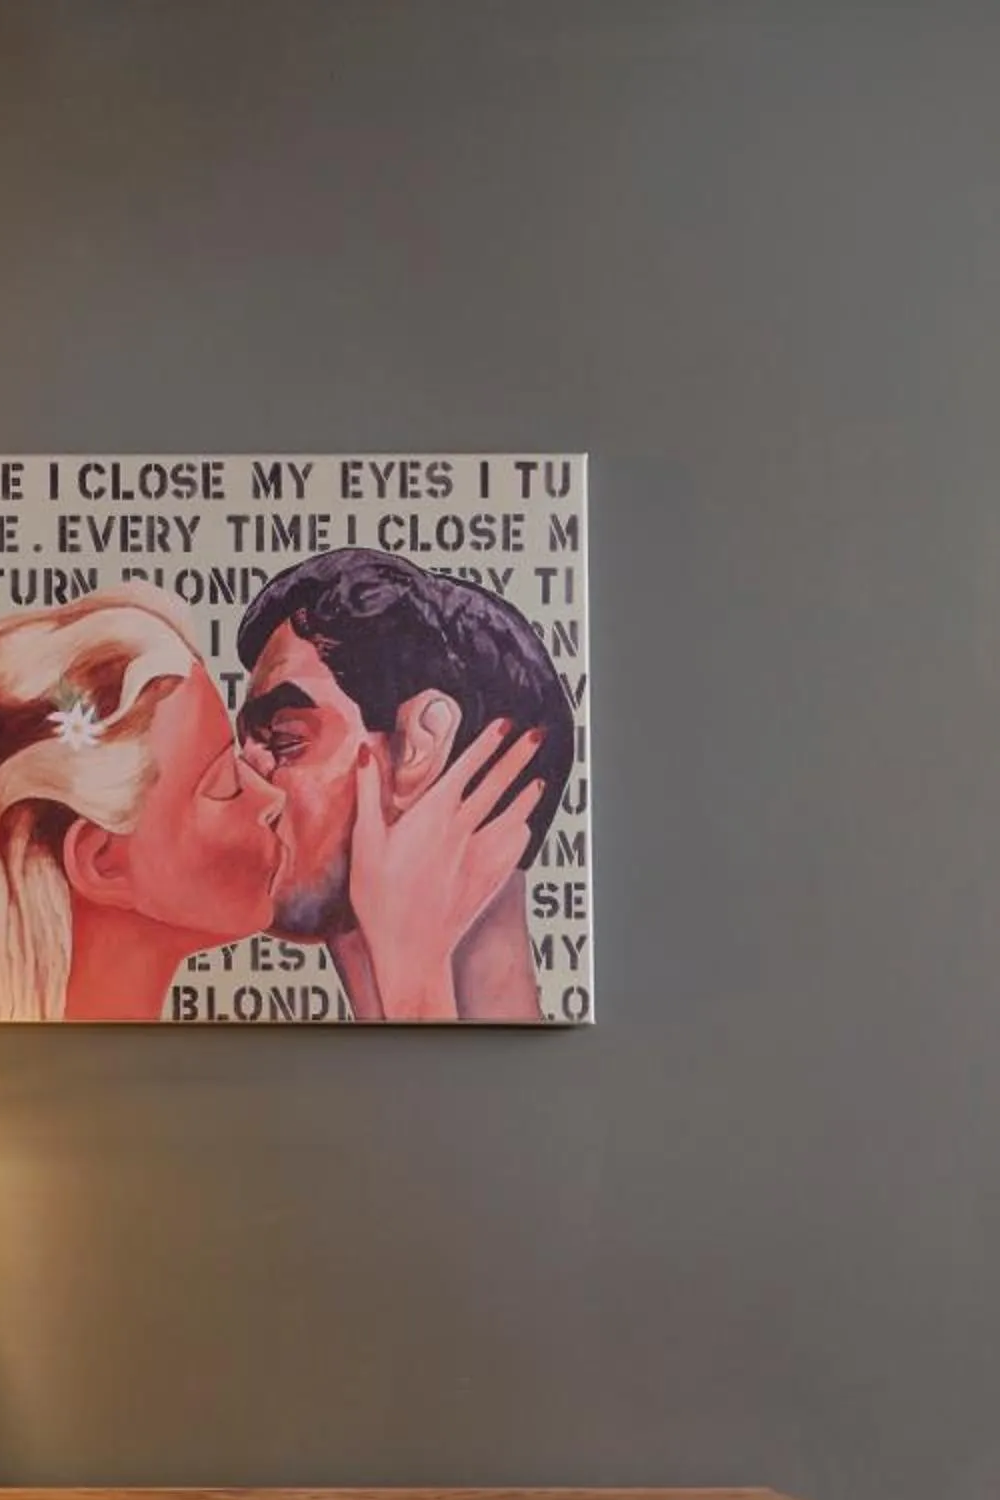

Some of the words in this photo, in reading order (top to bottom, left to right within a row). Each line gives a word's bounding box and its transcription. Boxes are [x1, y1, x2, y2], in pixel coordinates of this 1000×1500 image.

[49, 462, 59, 500] I
[77, 461, 226, 500] CLOSE
[252, 461, 313, 500] MY
[340, 460, 454, 499] EYES
[480, 461, 490, 499] I
[515, 460, 572, 499] TU
[57, 515, 201, 553] EVERY
[227, 514, 331, 553] TIME
[347, 514, 357, 545] I
[377, 513, 525, 552] CLOSE
[549, 513, 579, 552] M
[534, 566, 574, 605] TI
[211, 620, 220, 657] I
[220, 673, 244, 710] T
[532, 882, 588, 919] SE
